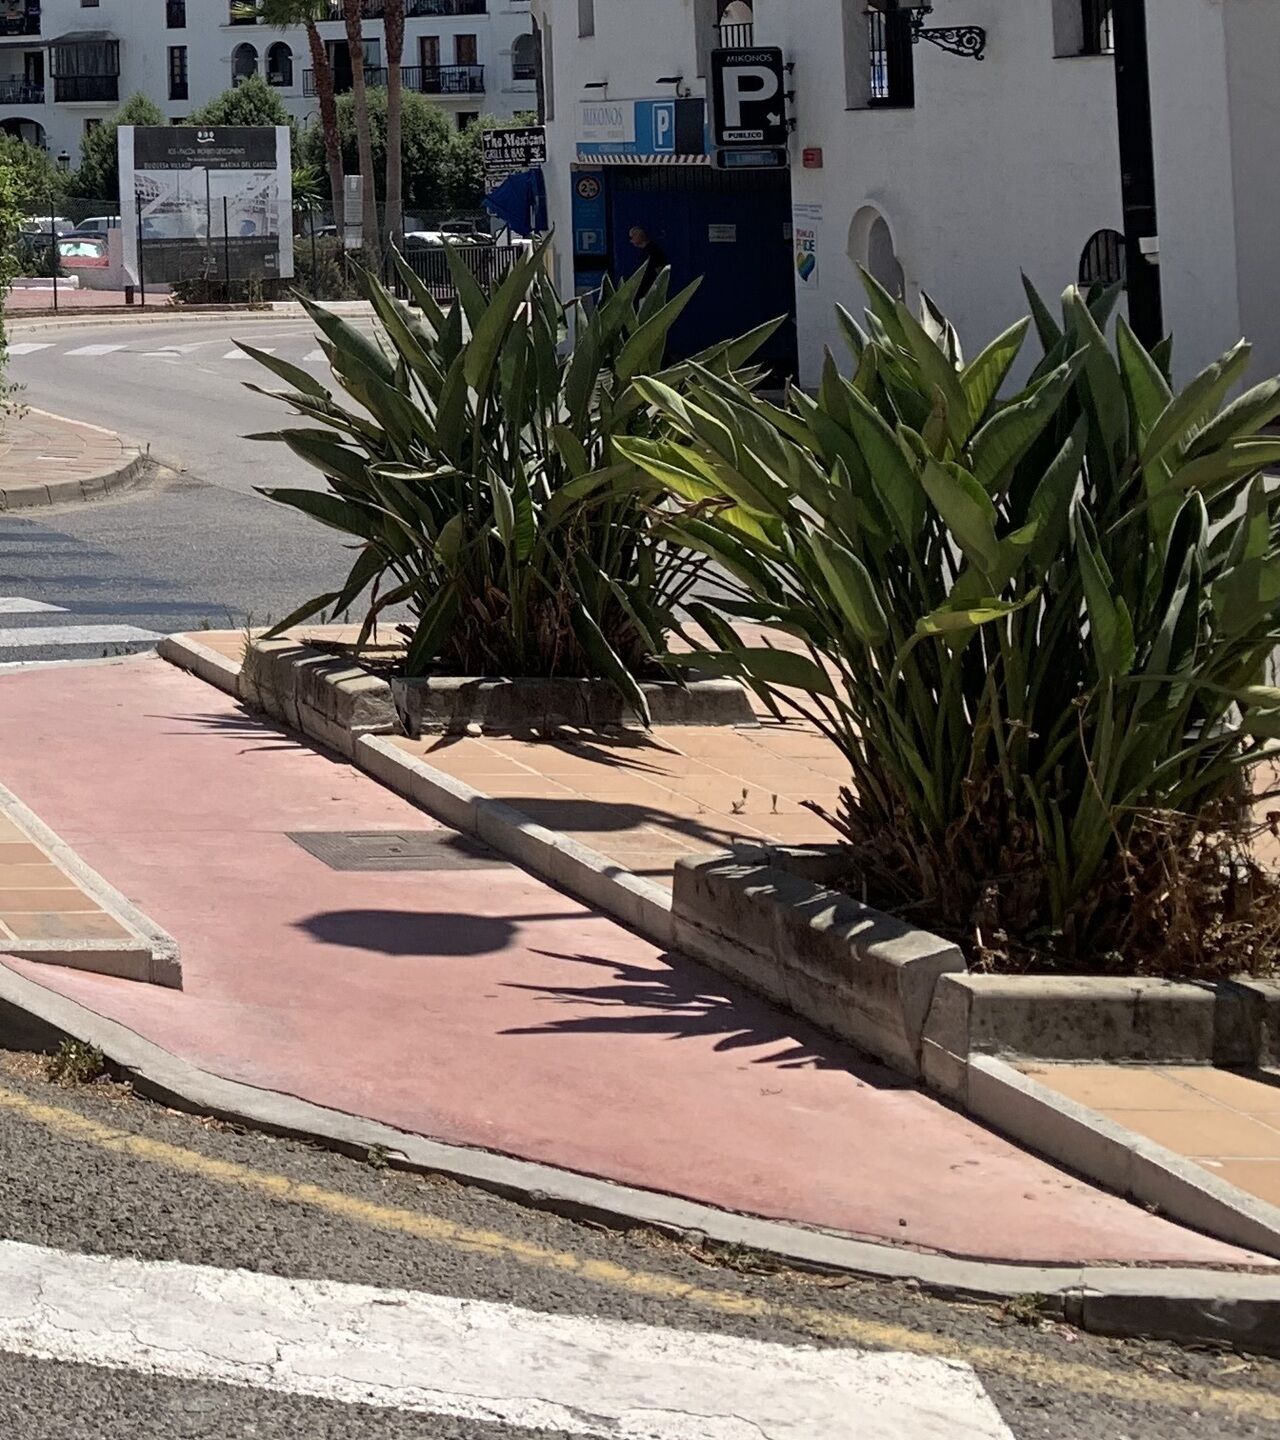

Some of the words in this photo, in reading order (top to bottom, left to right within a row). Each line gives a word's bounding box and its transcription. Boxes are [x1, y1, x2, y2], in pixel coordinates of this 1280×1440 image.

[726, 54, 773, 62] MIKONOS
[722, 65, 779, 128] P
[583, 107, 624, 126] MIKONOS
[657, 109, 669, 145] P
[483, 131, 503, 148] The
[504, 132, 545, 147] Mexican
[485, 150, 502, 160] GRILL
[511, 148, 525, 158] BAR
